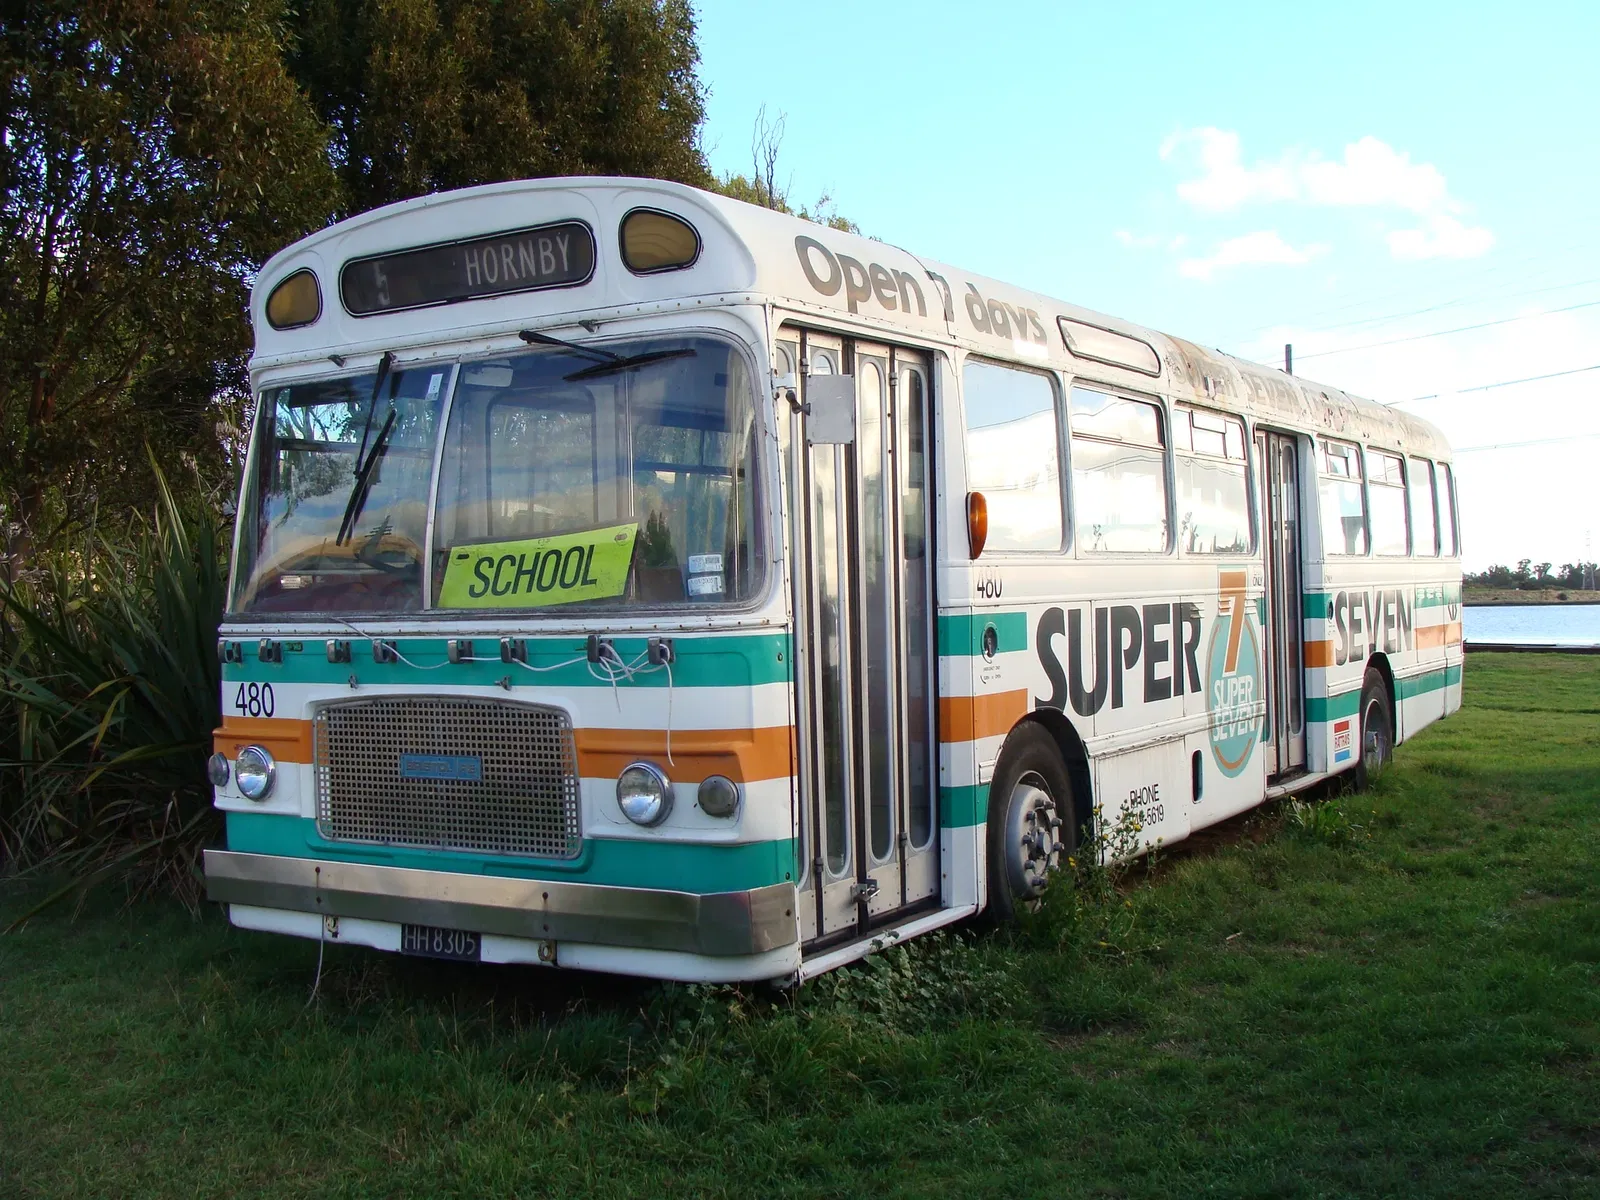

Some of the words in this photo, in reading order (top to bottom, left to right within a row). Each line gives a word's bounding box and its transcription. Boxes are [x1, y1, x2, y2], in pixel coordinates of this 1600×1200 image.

[465, 234, 570, 286] HORNBY
[794, 235, 927, 317] Open
[468, 544, 597, 598] SCHOOL
[977, 570, 1002, 599] 480
[1218, 570, 1247, 677] 7
[1335, 589, 1413, 666] SEVEN
[1035, 601, 1202, 717] SUPER
[235, 682, 275, 718] 480
[1214, 675, 1253, 707] SUPER
[1212, 702, 1256, 742] SEVEN
[1130, 783, 1160, 809] PHONE
[404, 923, 429, 951] HH
[433, 927, 476, 956] 8305
